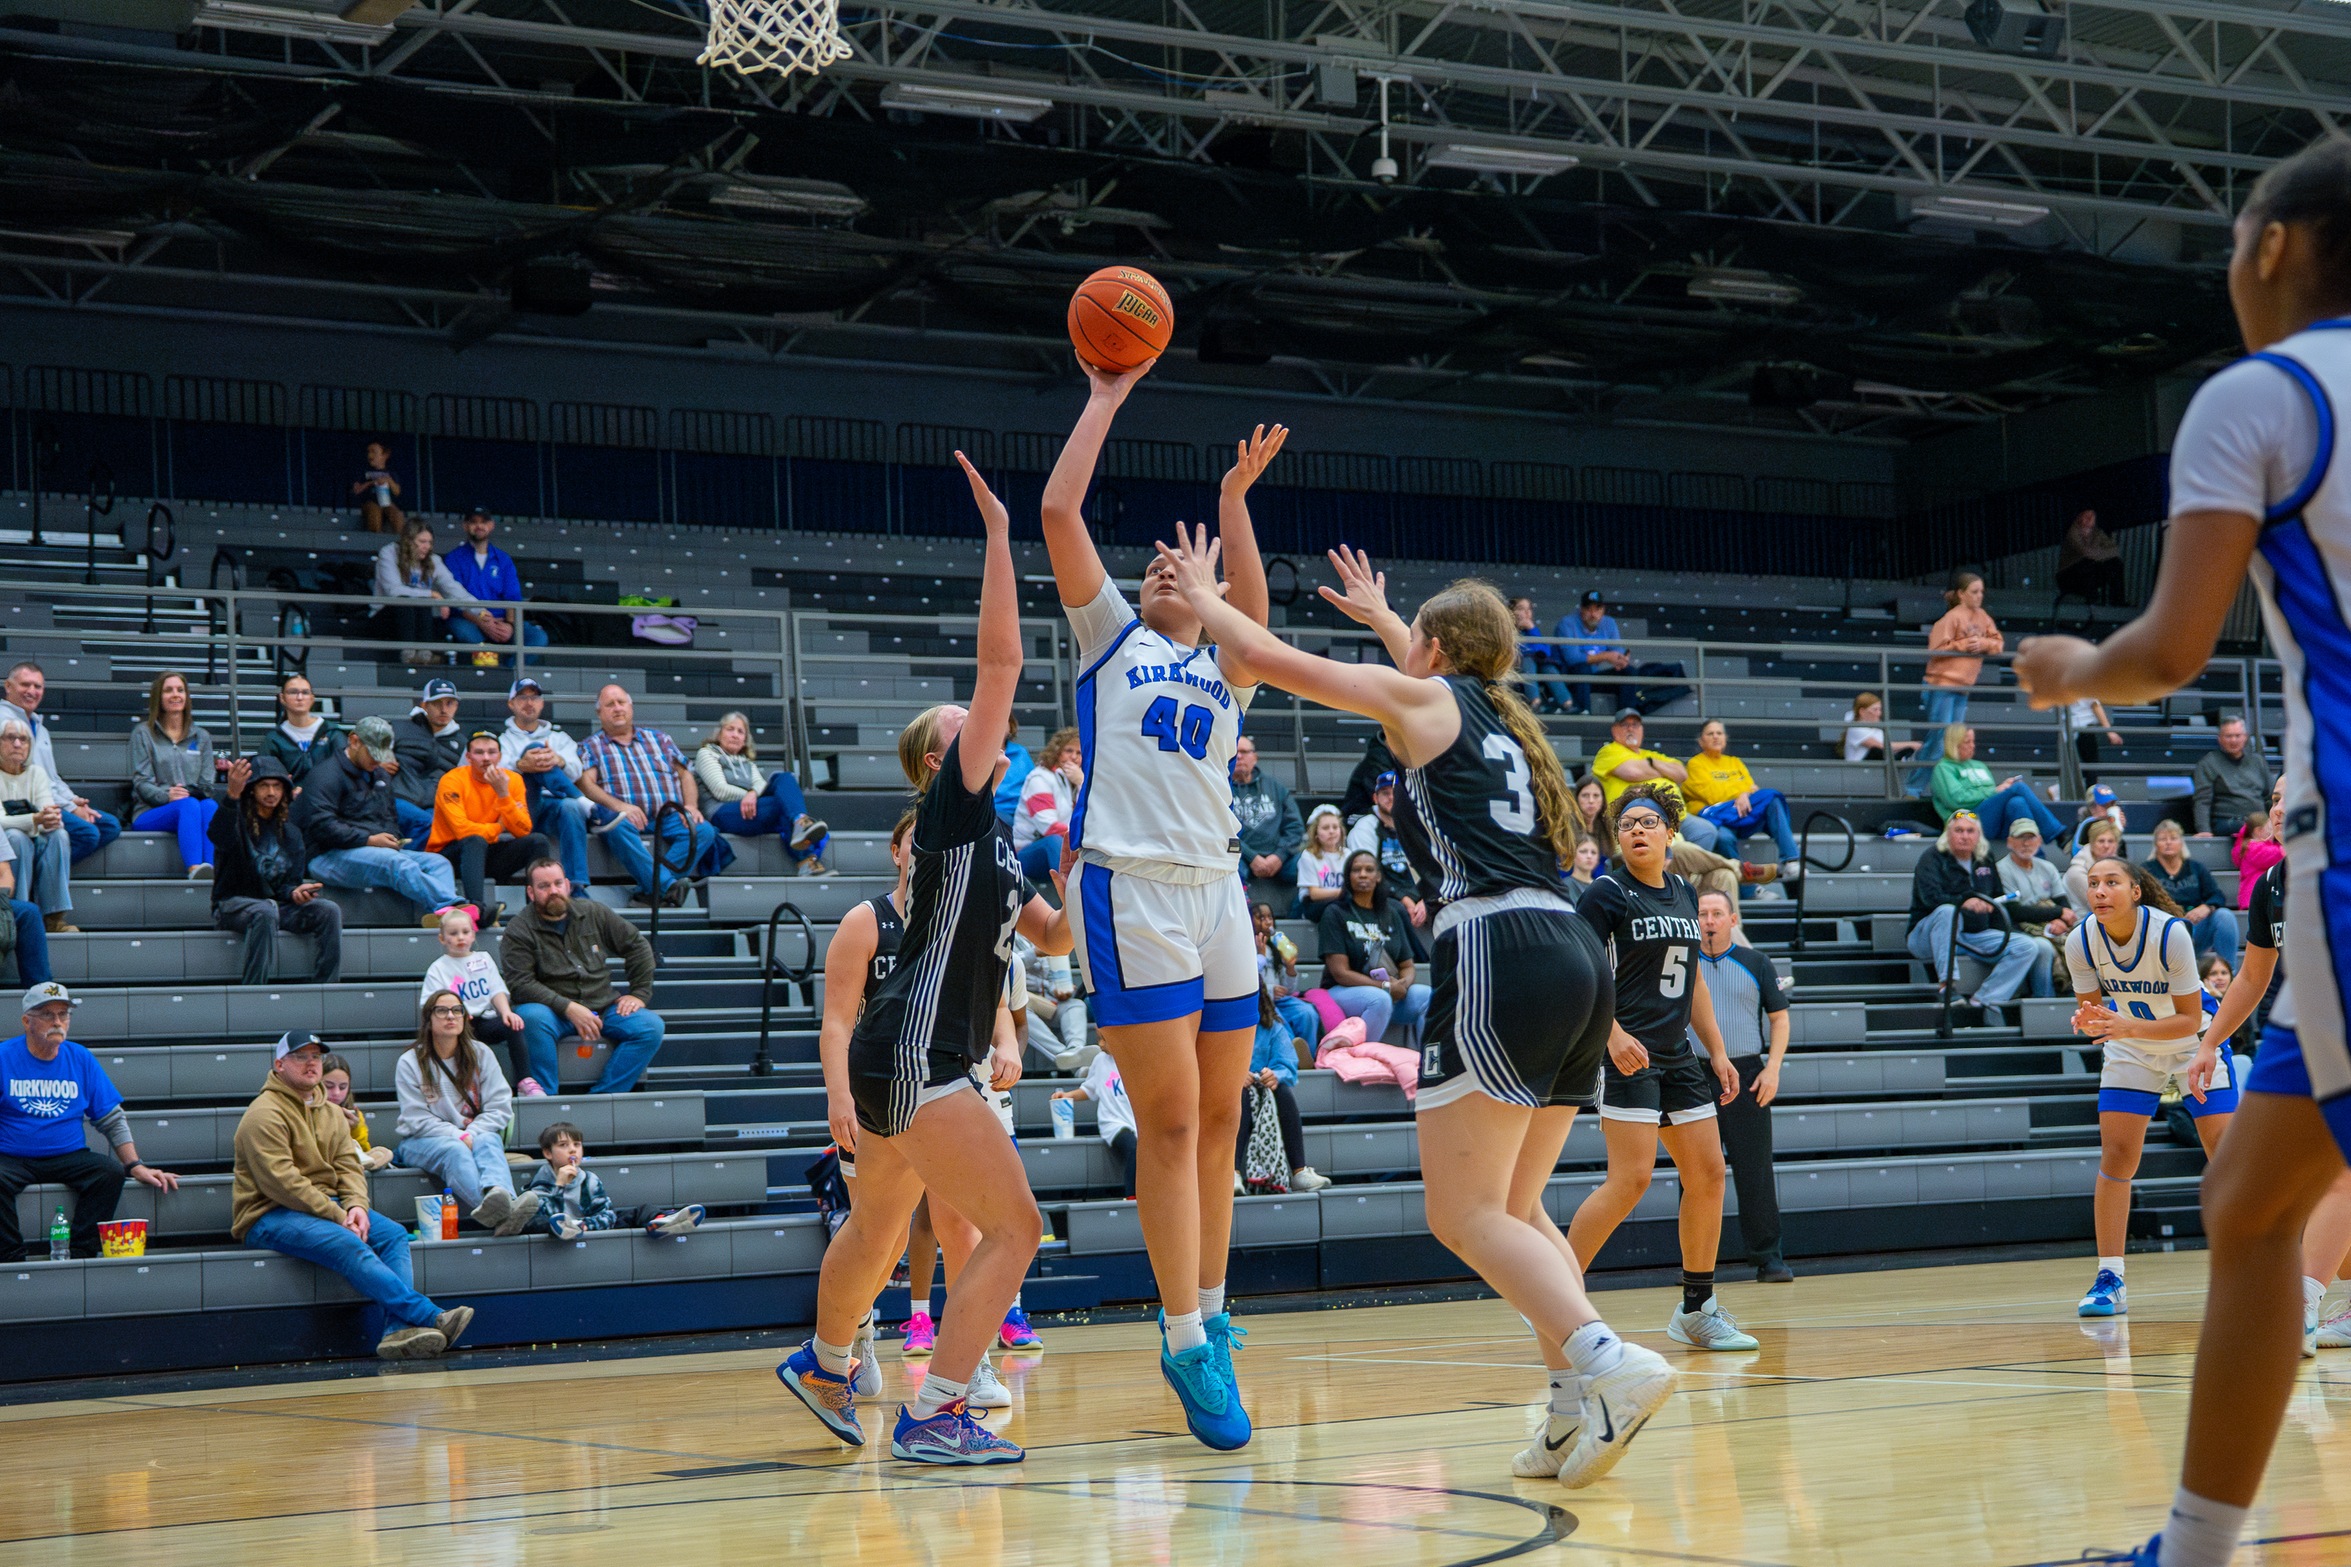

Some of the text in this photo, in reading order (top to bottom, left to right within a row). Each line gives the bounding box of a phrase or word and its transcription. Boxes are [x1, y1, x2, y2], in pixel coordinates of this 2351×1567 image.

[1125, 662, 1231, 710] KIRKWOOD
[1141, 695, 1215, 761] 40
[1482, 733, 1536, 835] 3
[457, 977, 490, 1001] KCC
[1659, 946, 1688, 998] 5
[10, 1079, 78, 1099] KIRKWOOD
